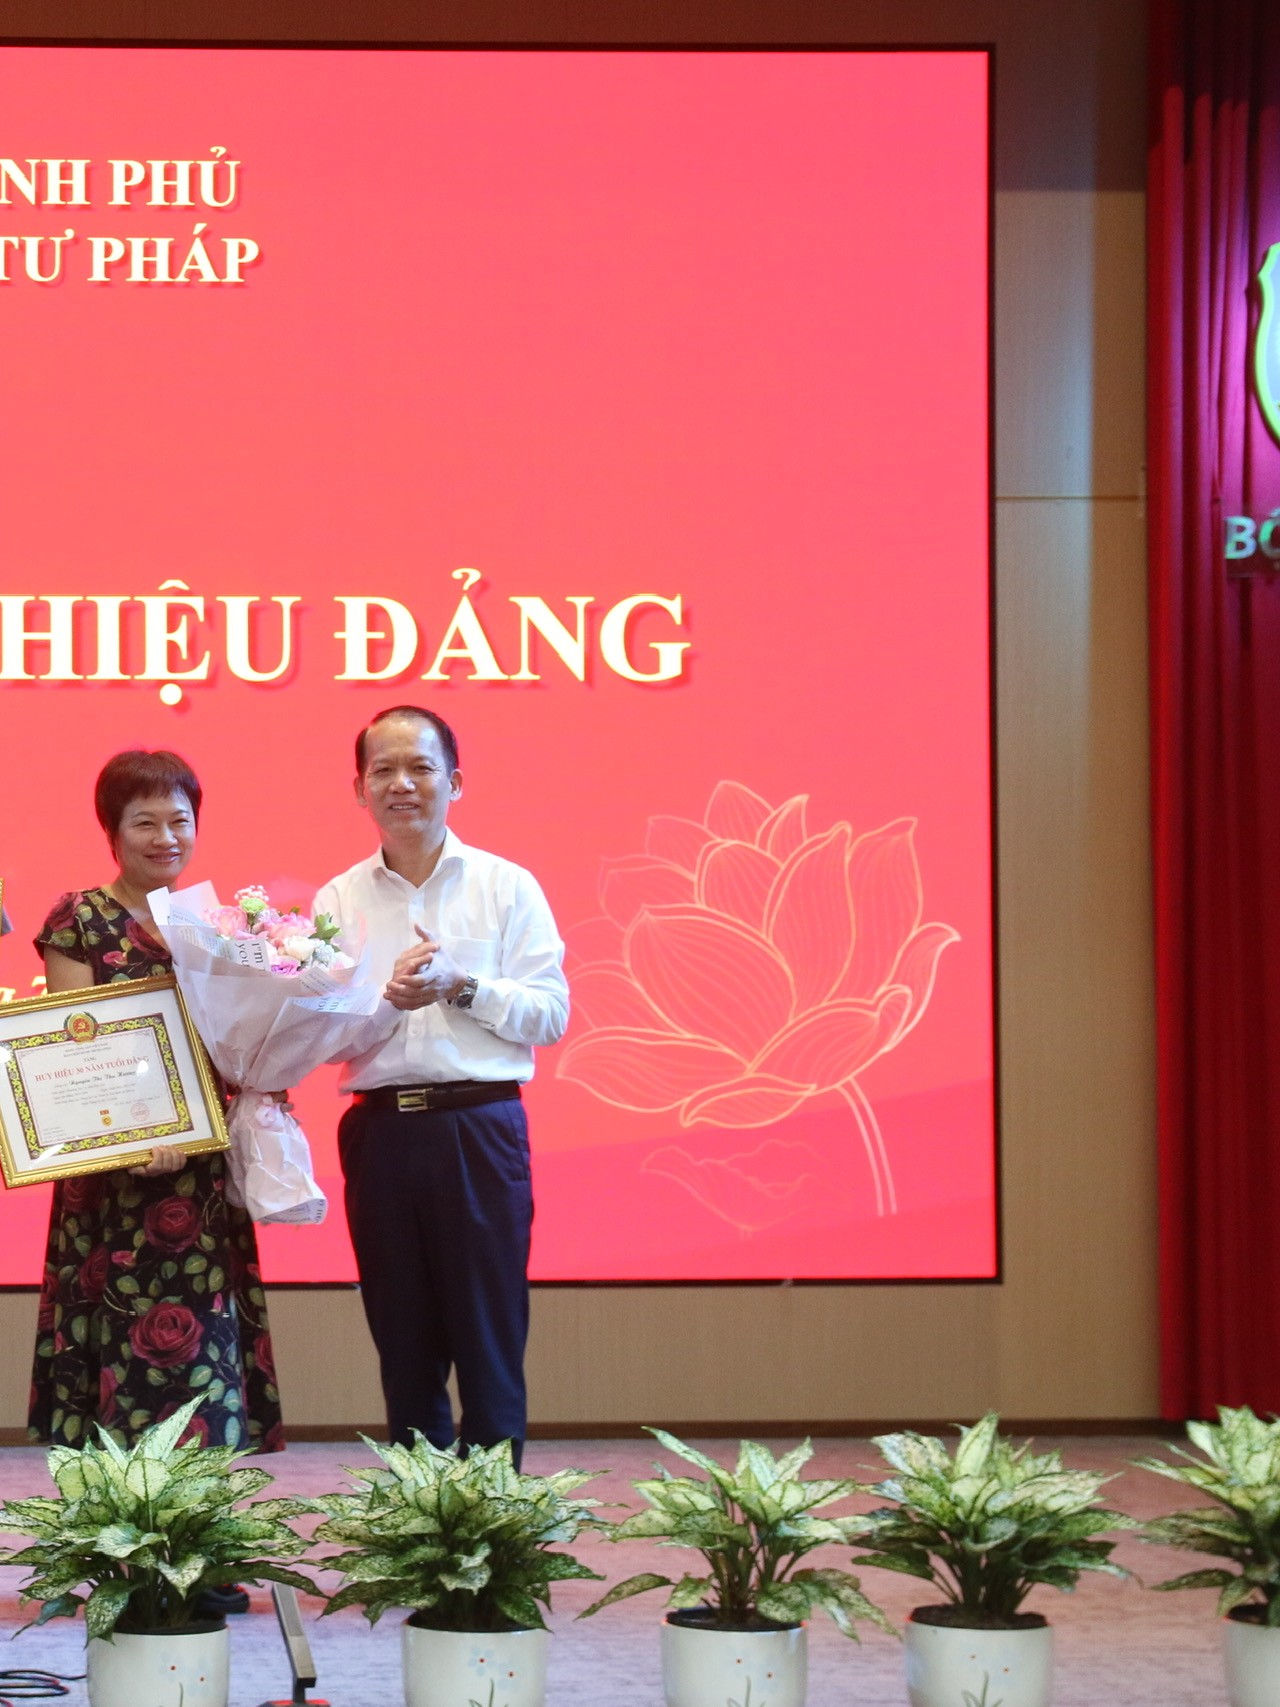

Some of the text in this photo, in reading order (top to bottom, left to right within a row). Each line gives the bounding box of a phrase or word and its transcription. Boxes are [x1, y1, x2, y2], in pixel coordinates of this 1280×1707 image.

[107, 146, 241, 207] PHỦ
[86, 223, 259, 283] PHÁP
[333, 567, 691, 682] ĐẢNG
